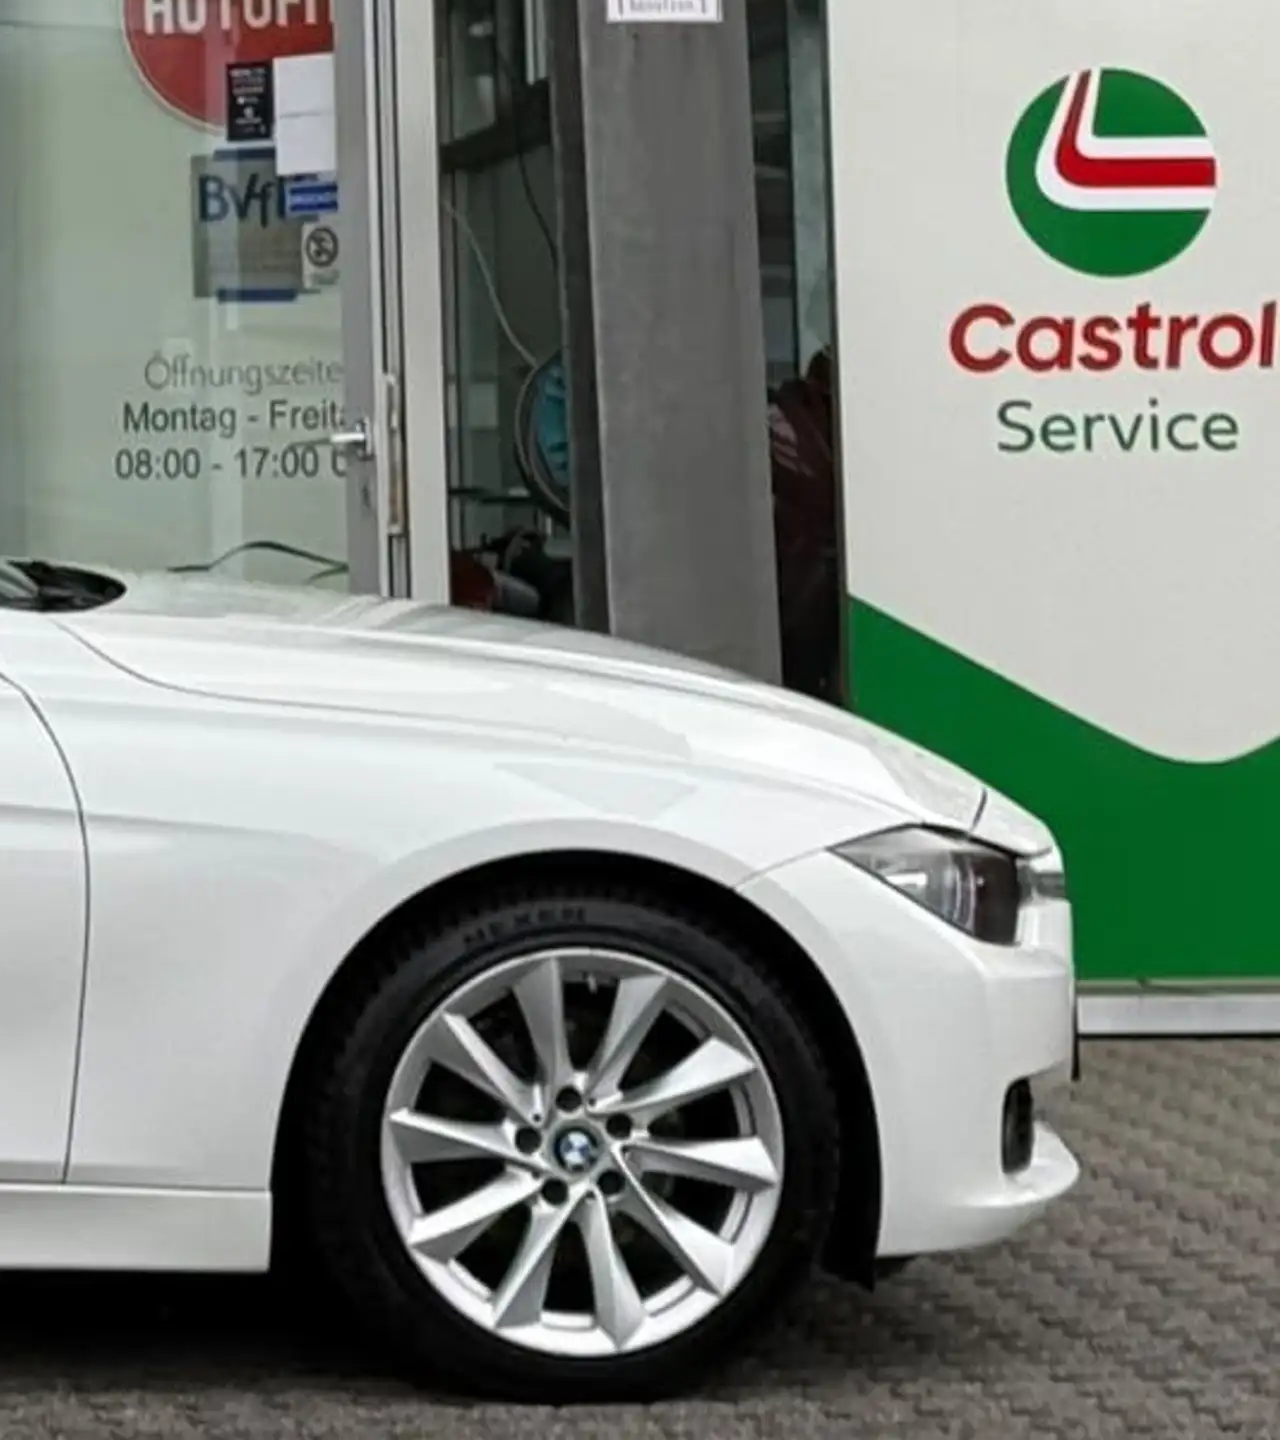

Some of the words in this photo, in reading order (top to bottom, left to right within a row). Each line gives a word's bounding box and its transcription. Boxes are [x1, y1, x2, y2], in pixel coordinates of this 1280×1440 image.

[948, 299, 1277, 374] Castrol
[123, 401, 237, 438] Montag
[996, 397, 1240, 453] Service
[115, 448, 200, 480] 08:00
[239, 445, 320, 479] 17:00
